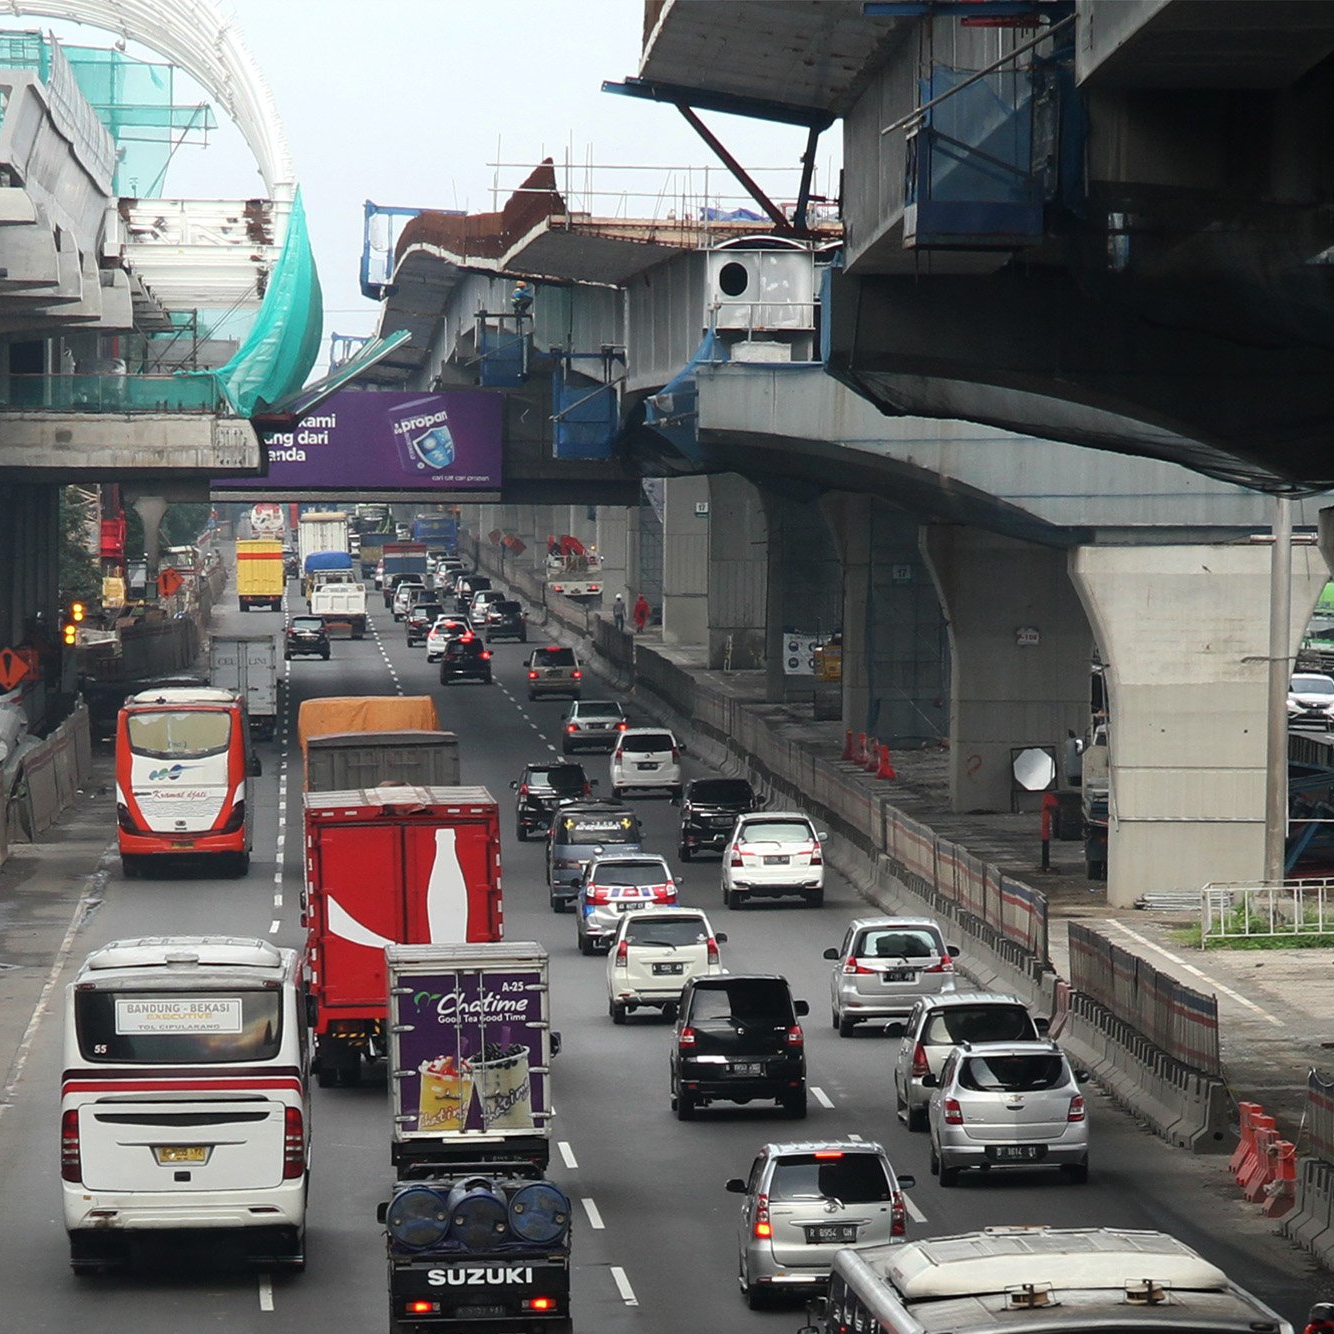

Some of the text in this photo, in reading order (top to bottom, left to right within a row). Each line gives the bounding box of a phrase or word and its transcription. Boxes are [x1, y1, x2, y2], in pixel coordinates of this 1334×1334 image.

[401, 411, 448, 433] propan
[298, 430, 329, 445] dari
[269, 447, 306, 462] anda
[501, 982, 525, 992] A-25
[127, 1003, 180, 1014] BANDUNG
[190, 1003, 230, 1013] BEKASI
[436, 992, 529, 1014] Chatime
[463, 1014, 478, 1022] Tea
[504, 1013, 526, 1021] Time
[94, 1044, 108, 1054] 55
[428, 1267, 533, 1286] SUZUKI
